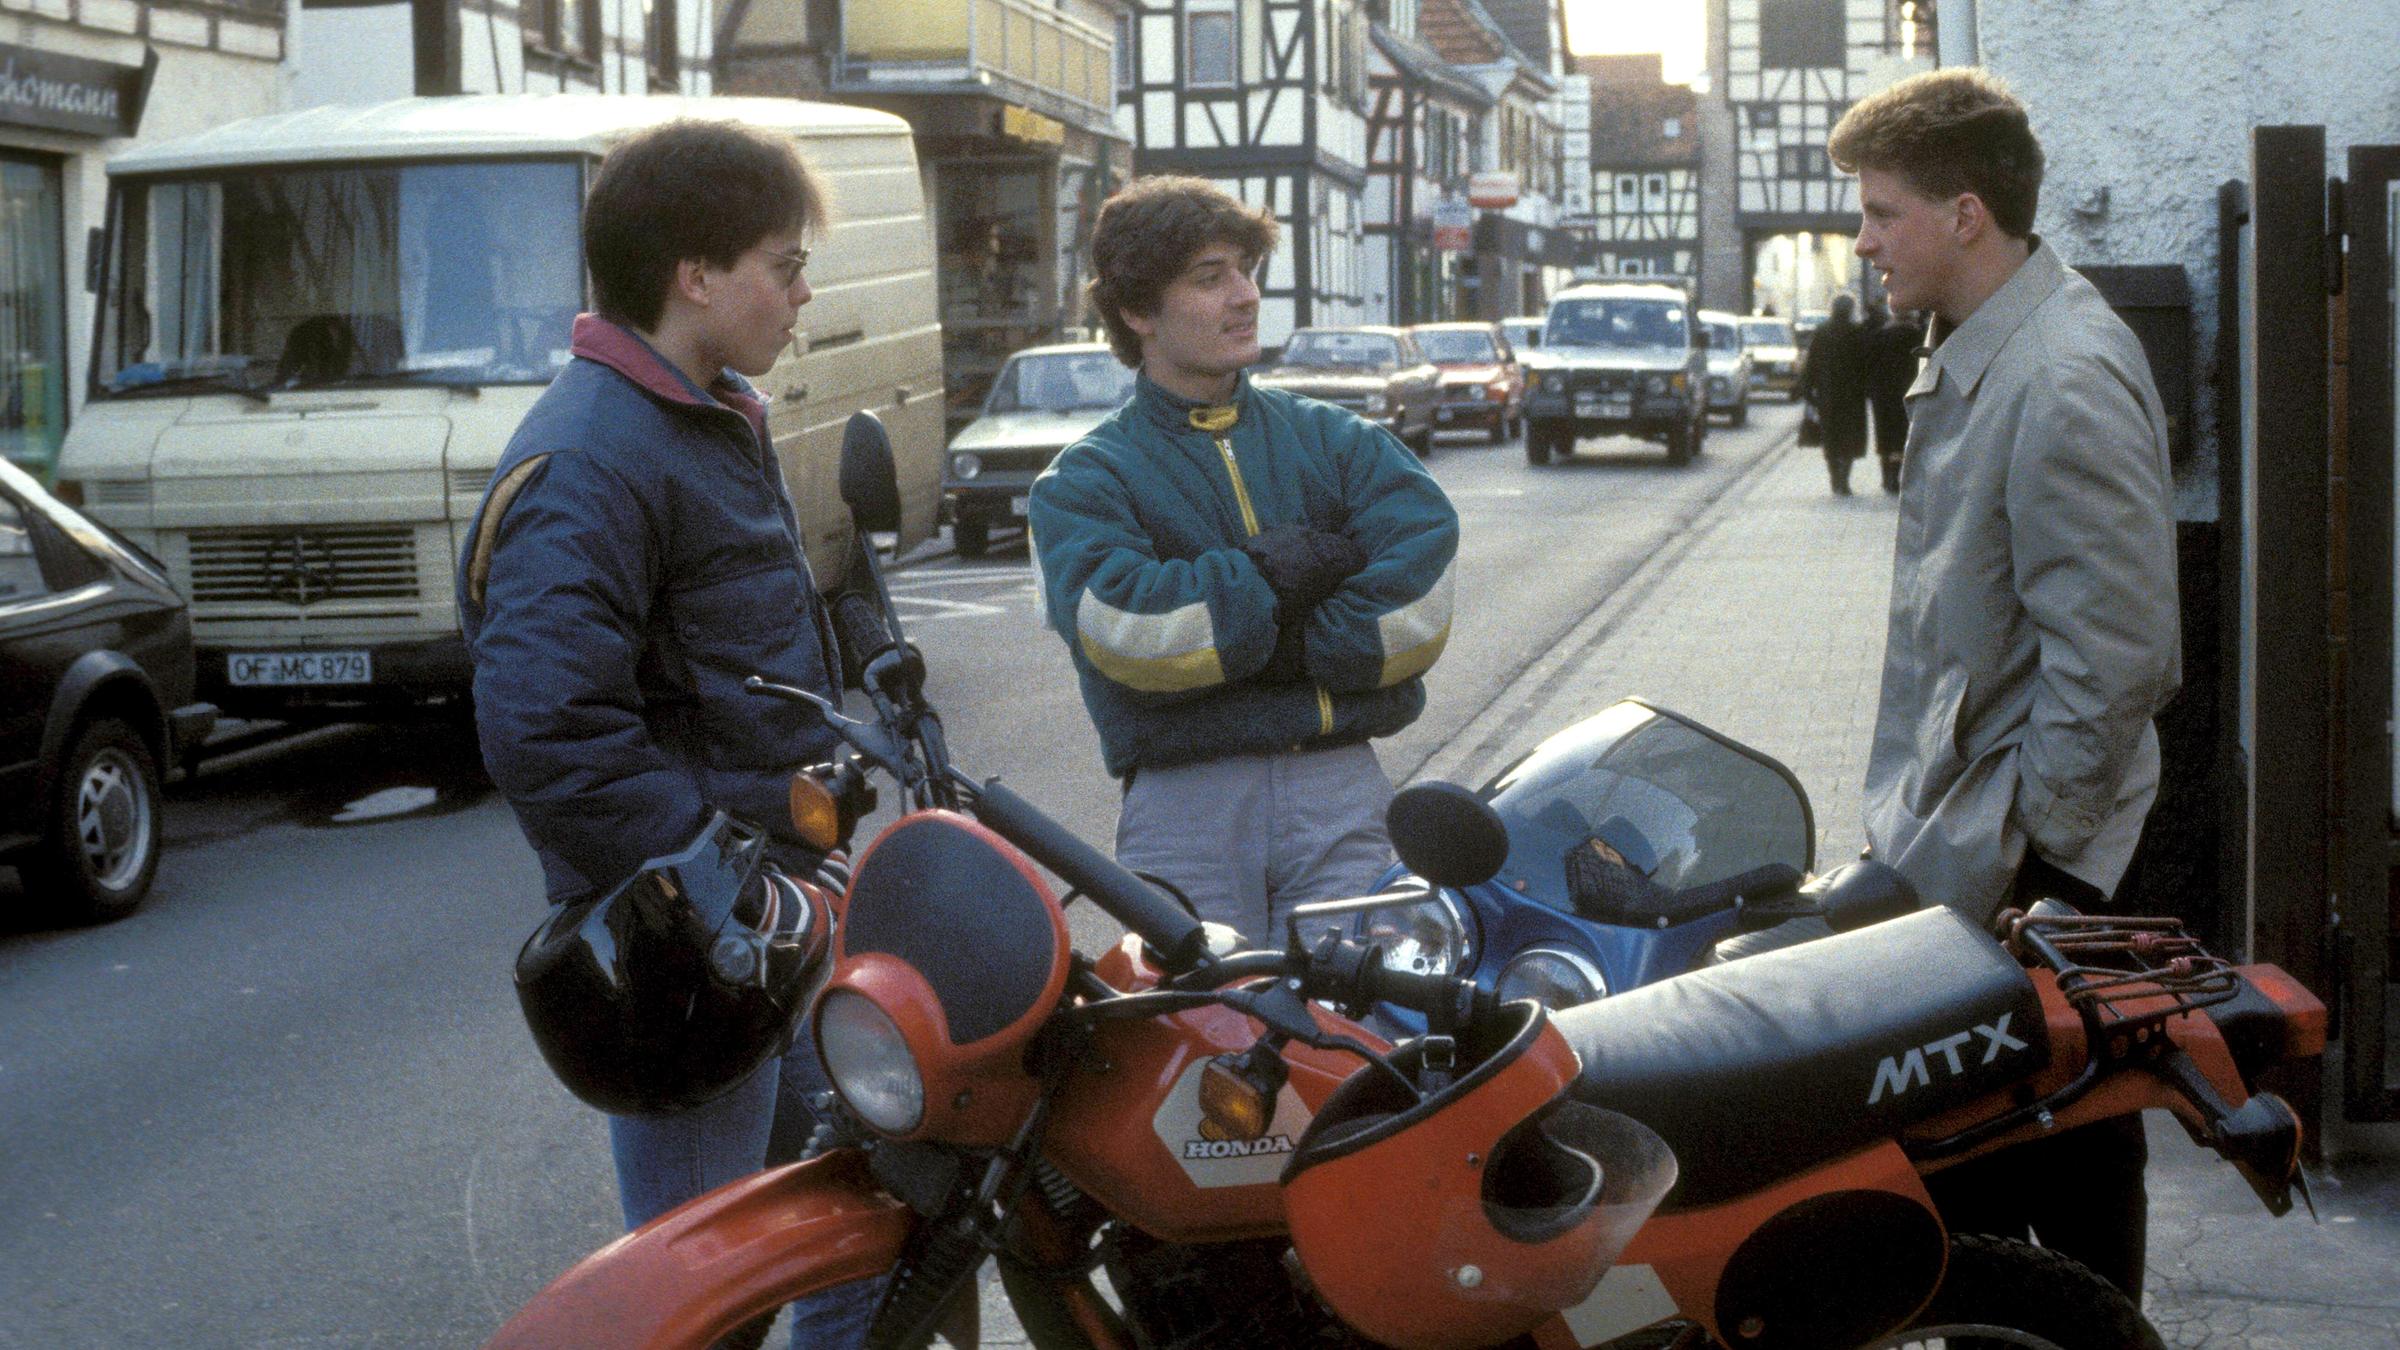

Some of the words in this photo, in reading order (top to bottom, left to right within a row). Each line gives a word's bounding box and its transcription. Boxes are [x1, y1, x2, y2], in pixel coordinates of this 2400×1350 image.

[321, 656, 365, 679] 879
[1868, 1012, 2029, 1104] MTX
[1185, 1134, 1294, 1158] HONDA
